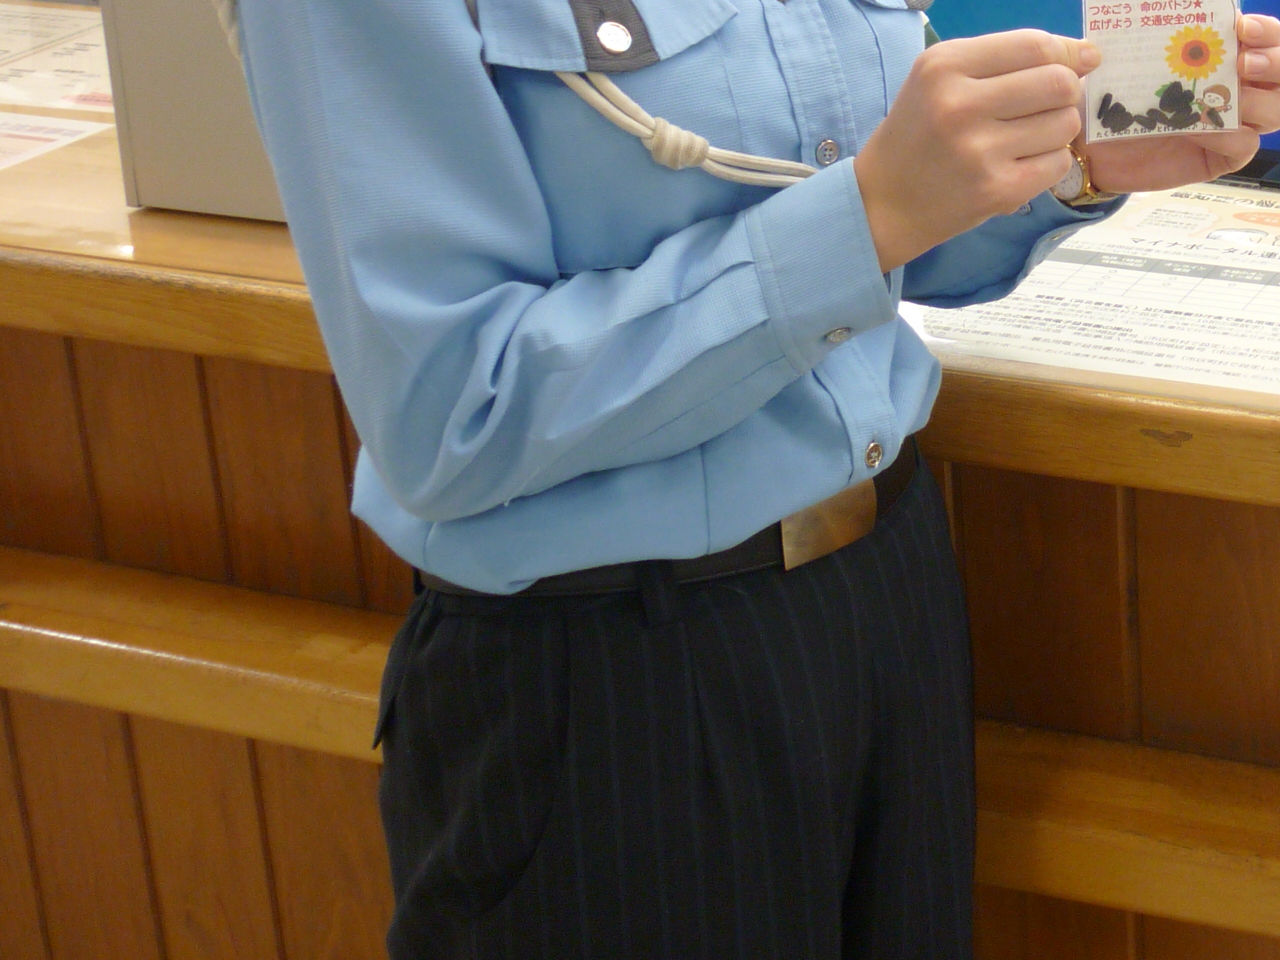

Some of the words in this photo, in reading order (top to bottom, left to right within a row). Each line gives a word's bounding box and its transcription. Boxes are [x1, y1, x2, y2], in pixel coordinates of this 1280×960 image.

[1089, 2, 1133, 17] つなごう
[1089, 17, 1133, 31] 広げよう
